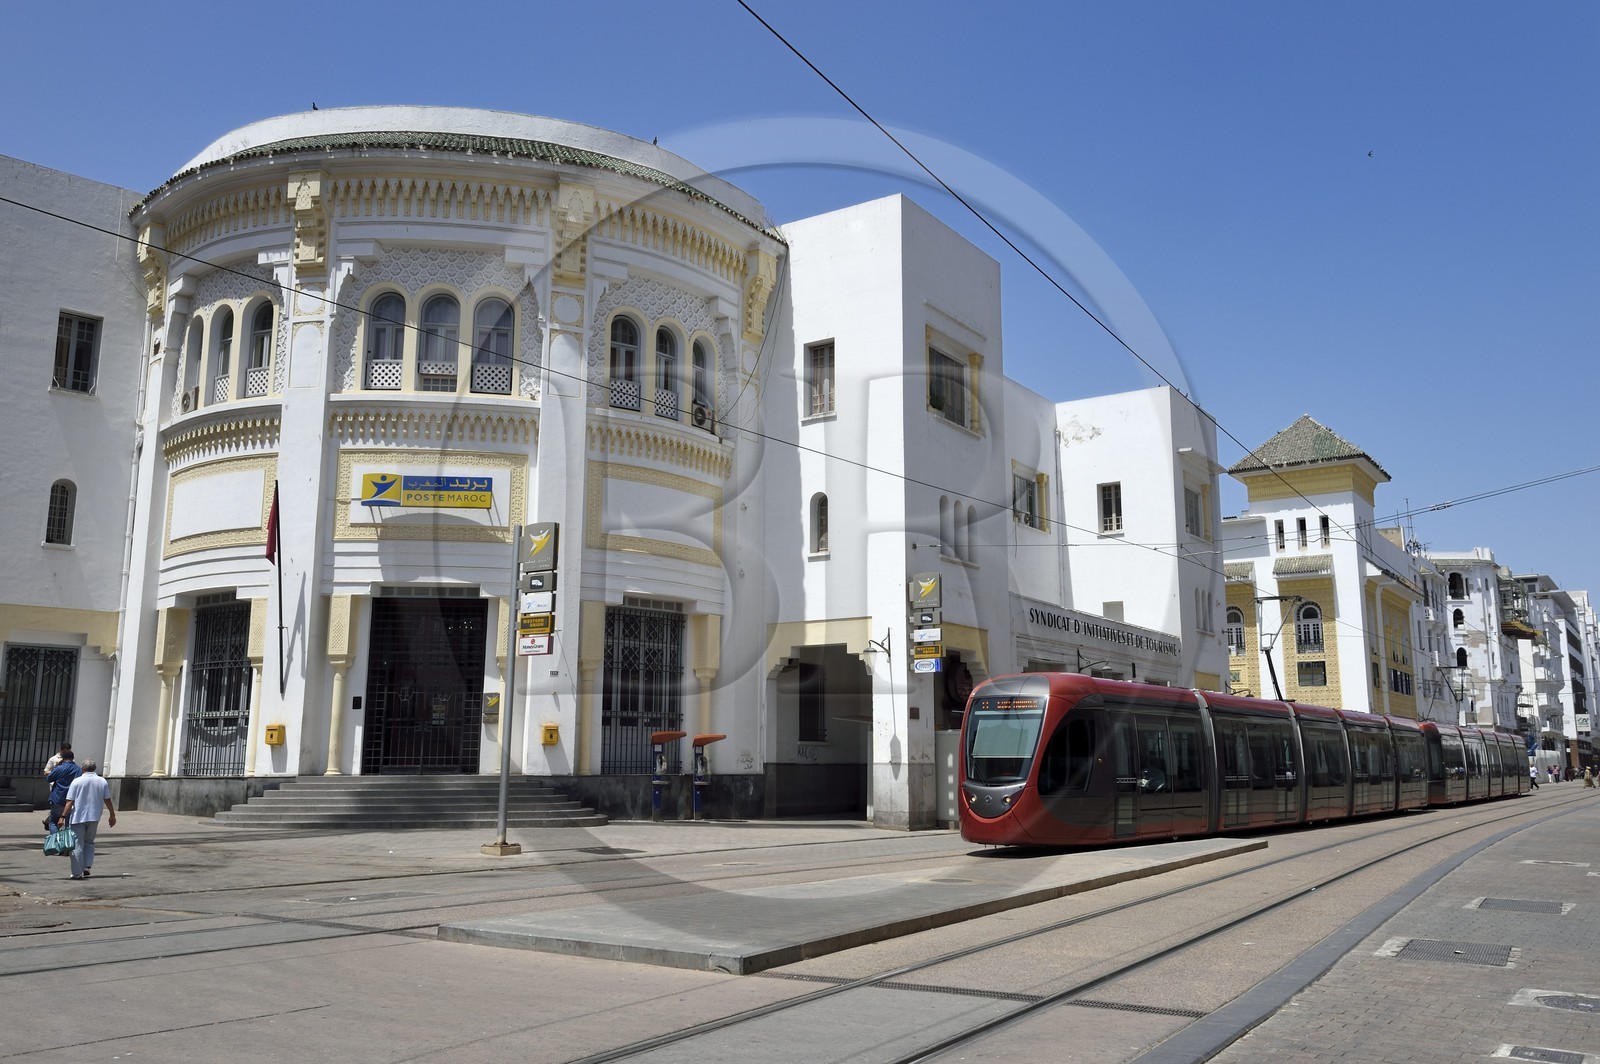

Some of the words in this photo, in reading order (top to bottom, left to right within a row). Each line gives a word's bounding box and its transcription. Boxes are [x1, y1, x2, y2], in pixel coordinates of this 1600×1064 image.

[407, 478, 447, 491] المغرب
[449, 478, 488, 491] بريد
[406, 493, 445, 502] POSTE
[447, 494, 487, 503] MAROC
[1029, 607, 1071, 632] SYNDICAT
[1135, 634, 1143, 650] DE
[1144, 636, 1178, 657] TOURISME
